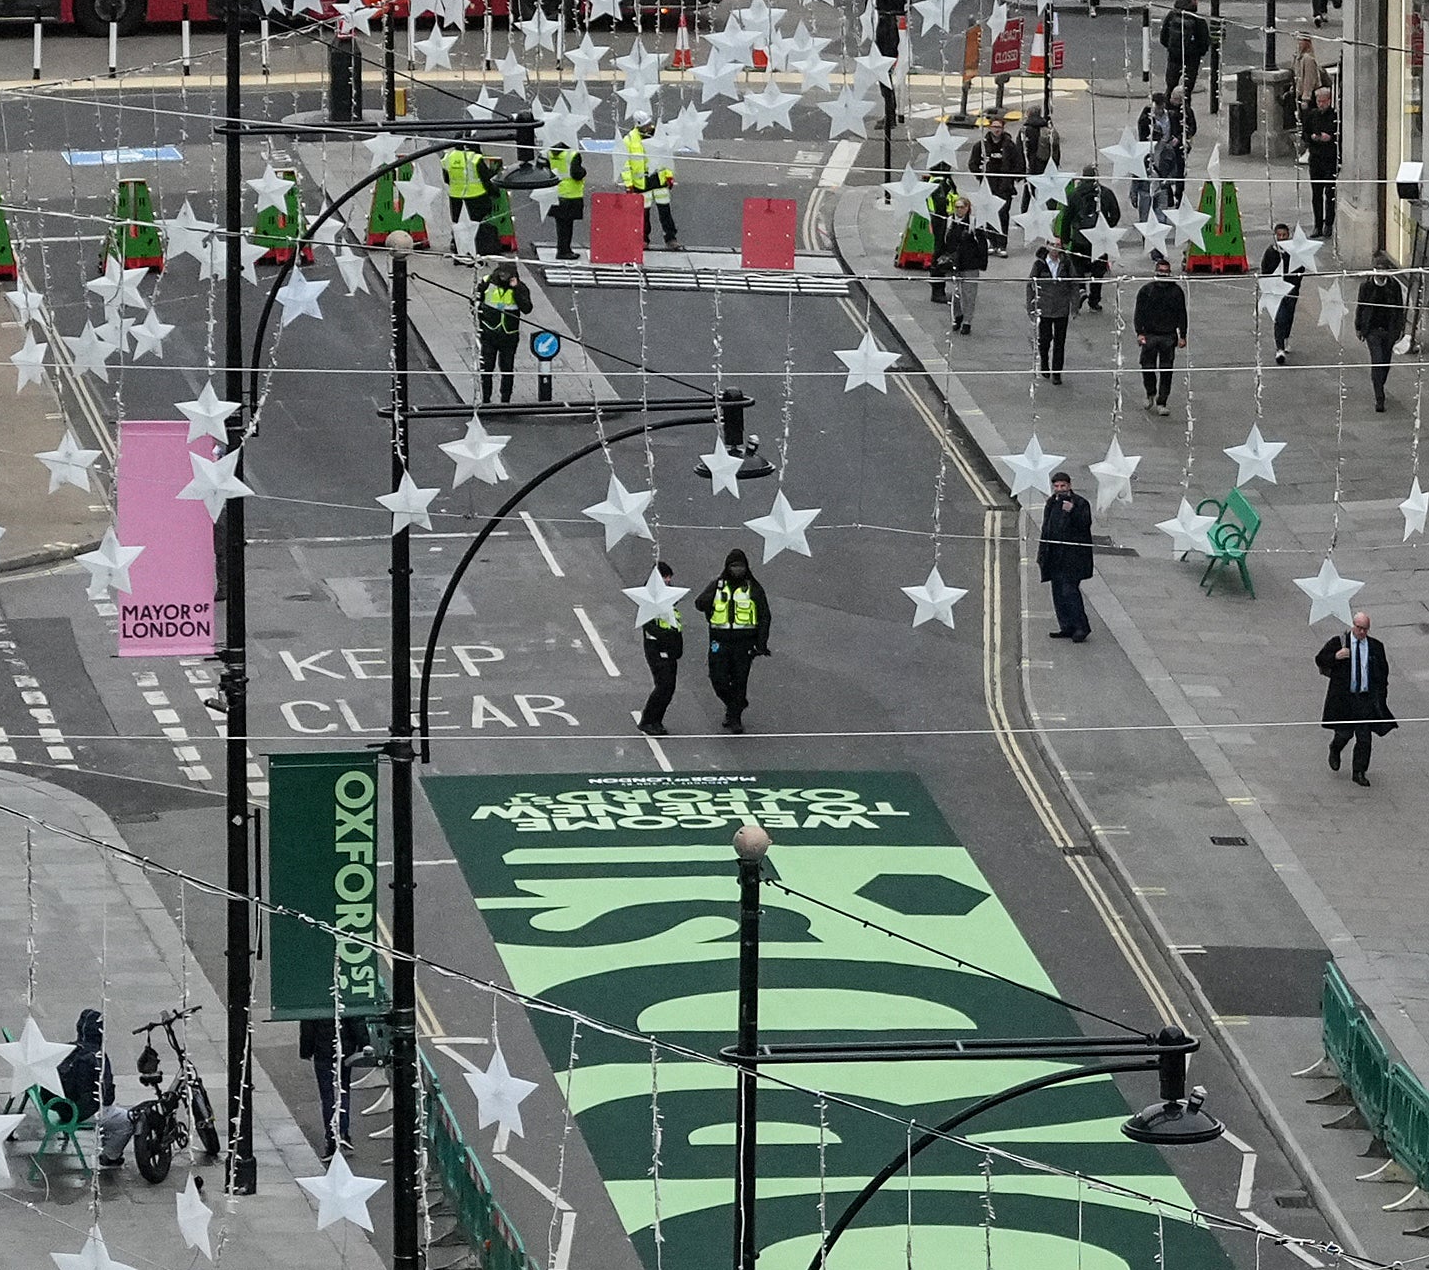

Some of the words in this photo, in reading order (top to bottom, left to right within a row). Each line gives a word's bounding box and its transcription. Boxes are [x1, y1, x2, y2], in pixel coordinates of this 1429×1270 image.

[995, 50, 1019, 64] CLOSED
[121, 604, 192, 622] MAYOR
[194, 603, 209, 613] OF
[121, 621, 211, 639] LONDON
[278, 645, 505, 682] KEEP
[278, 693, 579, 734] CLEAR
[587, 776, 672, 784] LONDON
[553, 788, 861, 804] OXFORD
[470, 803, 643, 820] NEW
[660, 801, 796, 817] THE
[808, 801, 911, 817] TO
[511, 813, 882, 833] WELCOME
[334, 770, 375, 966] OXFORD
[349, 964, 375, 1000] ST
